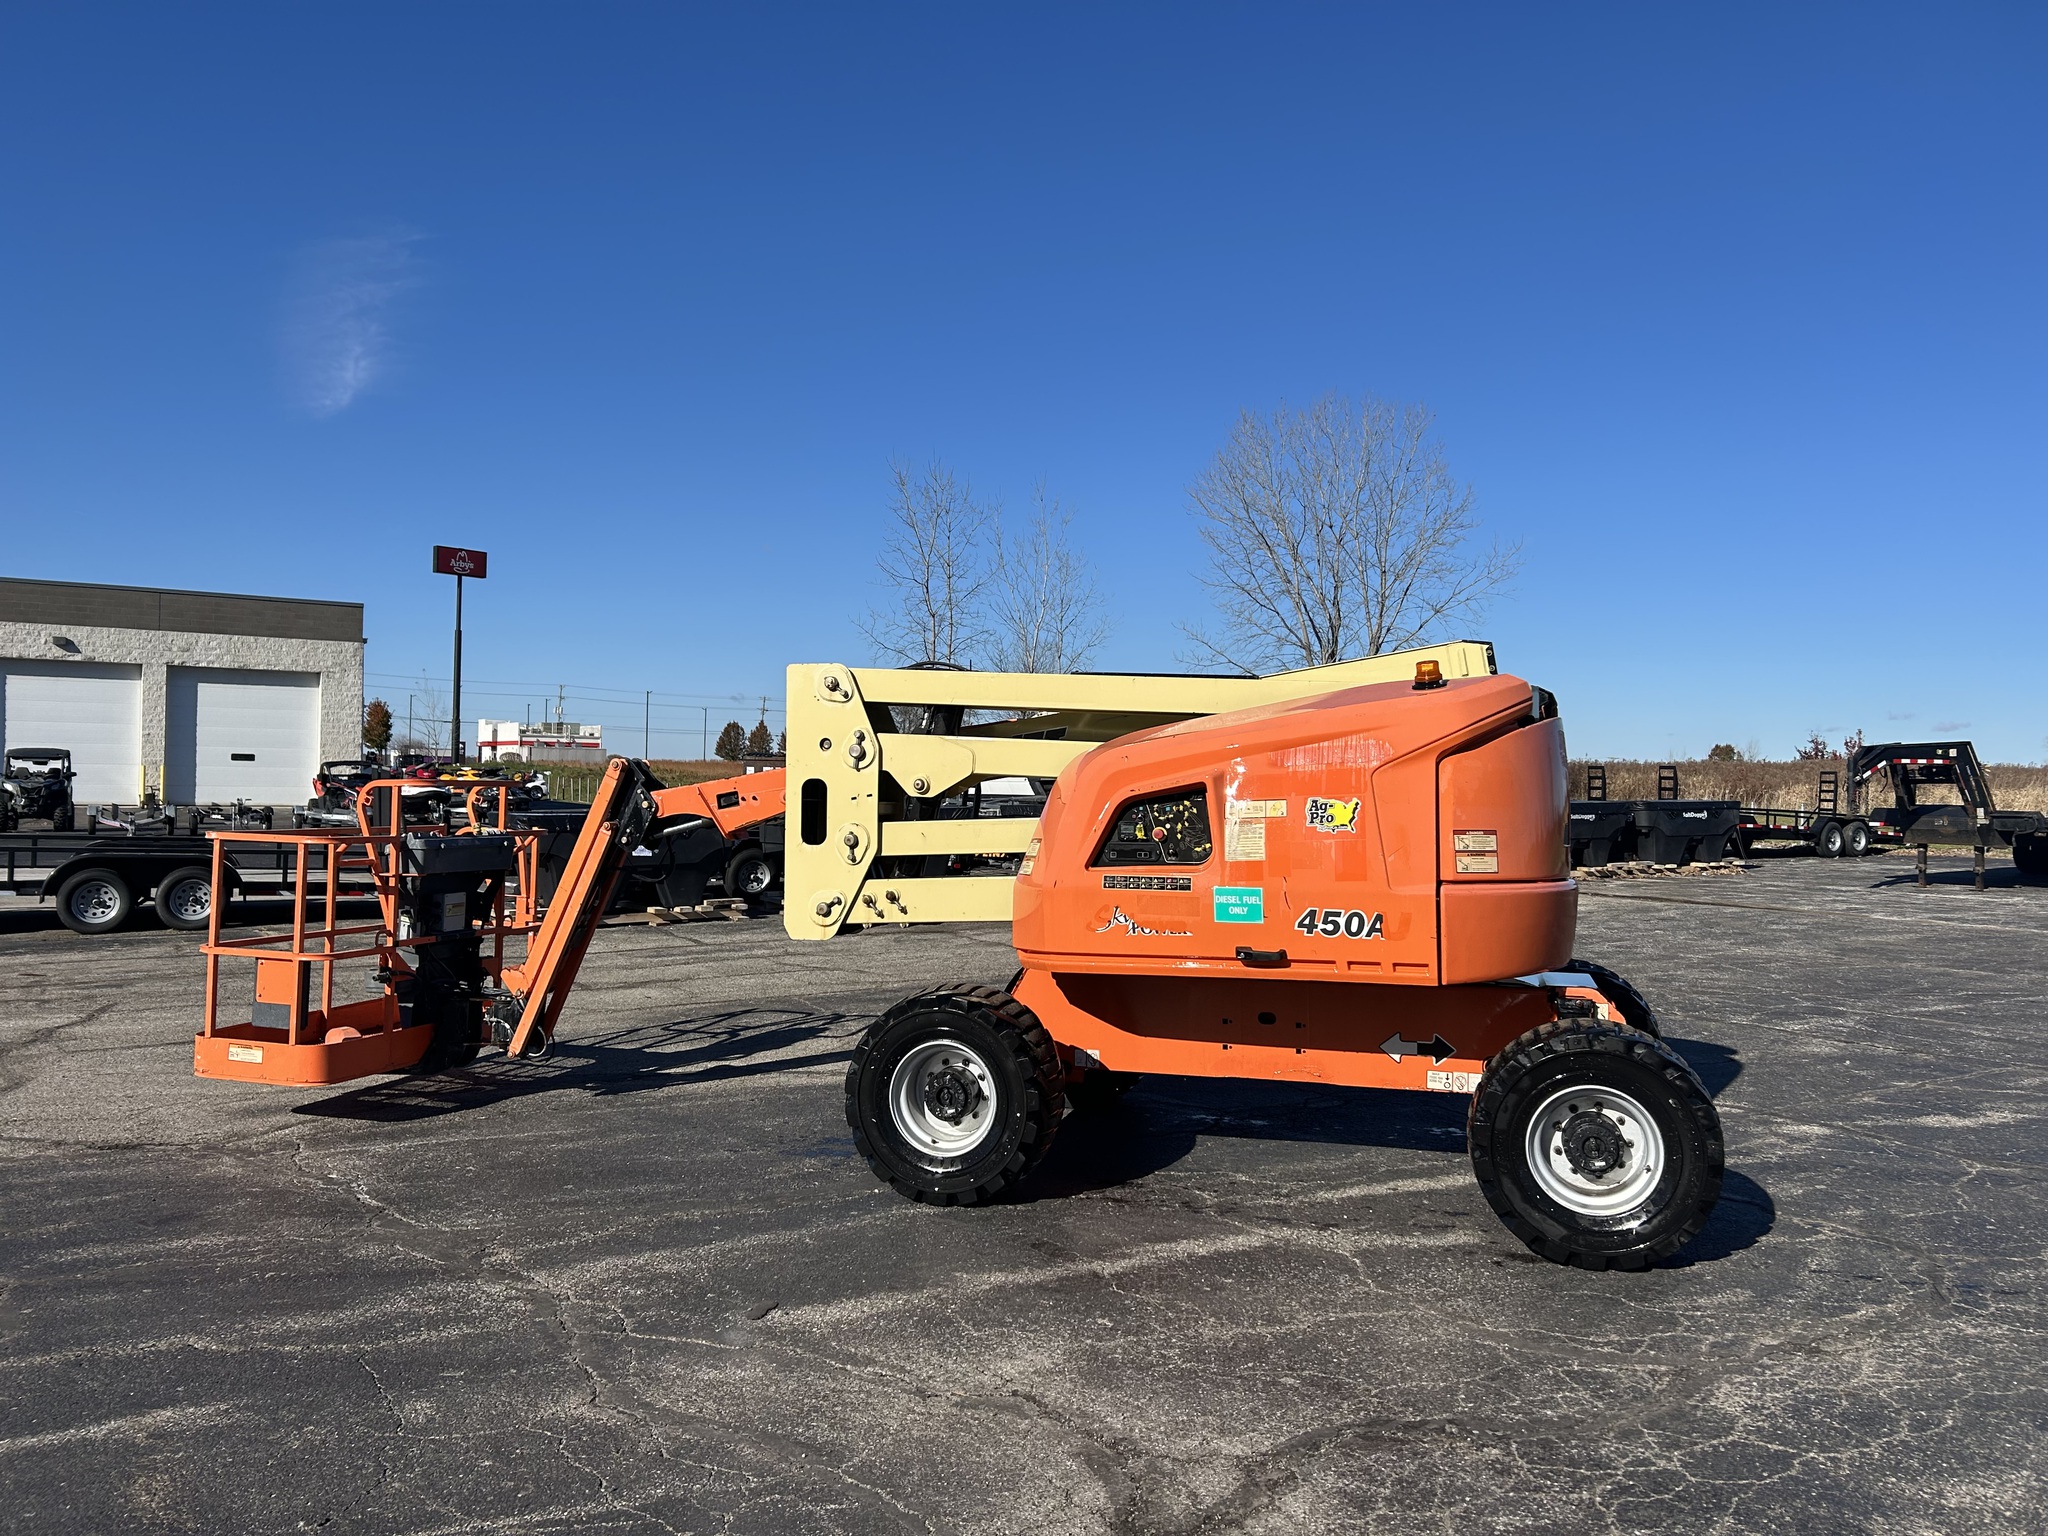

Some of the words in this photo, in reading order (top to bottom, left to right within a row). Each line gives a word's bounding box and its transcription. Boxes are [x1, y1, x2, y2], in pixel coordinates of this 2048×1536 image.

[450, 558, 475, 569] Arby's
[1309, 799, 1334, 813] Ag-
[1309, 811, 1334, 824] Pro
[1215, 895, 1241, 904] DIESEL
[1243, 895, 1261, 905] FUEL
[1228, 906, 1248, 915] ONLY
[1295, 908, 1384, 940] 450A
